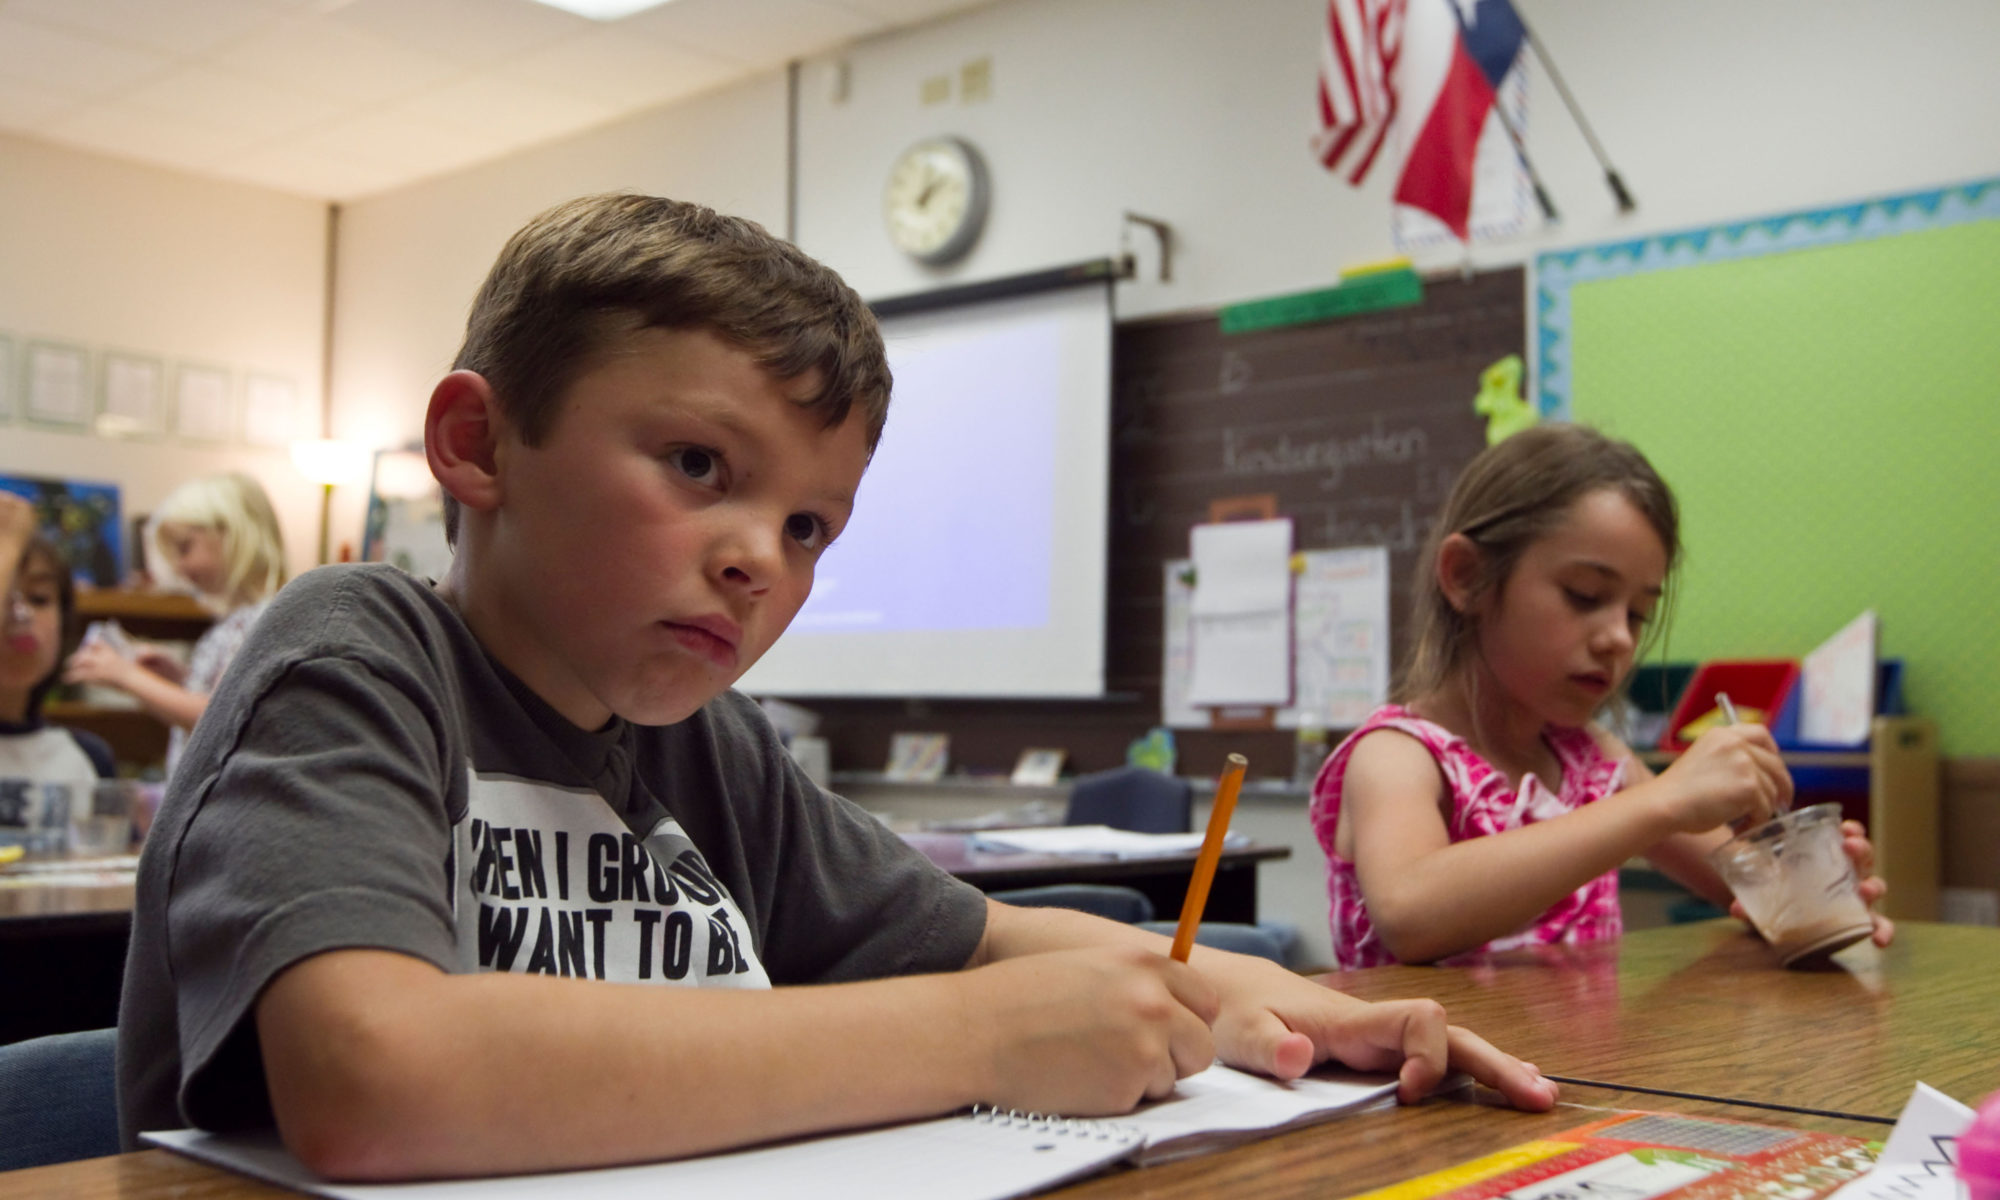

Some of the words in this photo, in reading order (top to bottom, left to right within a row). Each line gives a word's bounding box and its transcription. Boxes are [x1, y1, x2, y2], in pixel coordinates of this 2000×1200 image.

[555, 831, 569, 901] I
[478, 902, 613, 980] WANT
[634, 909, 693, 980] TO
[706, 907, 750, 977] BE
